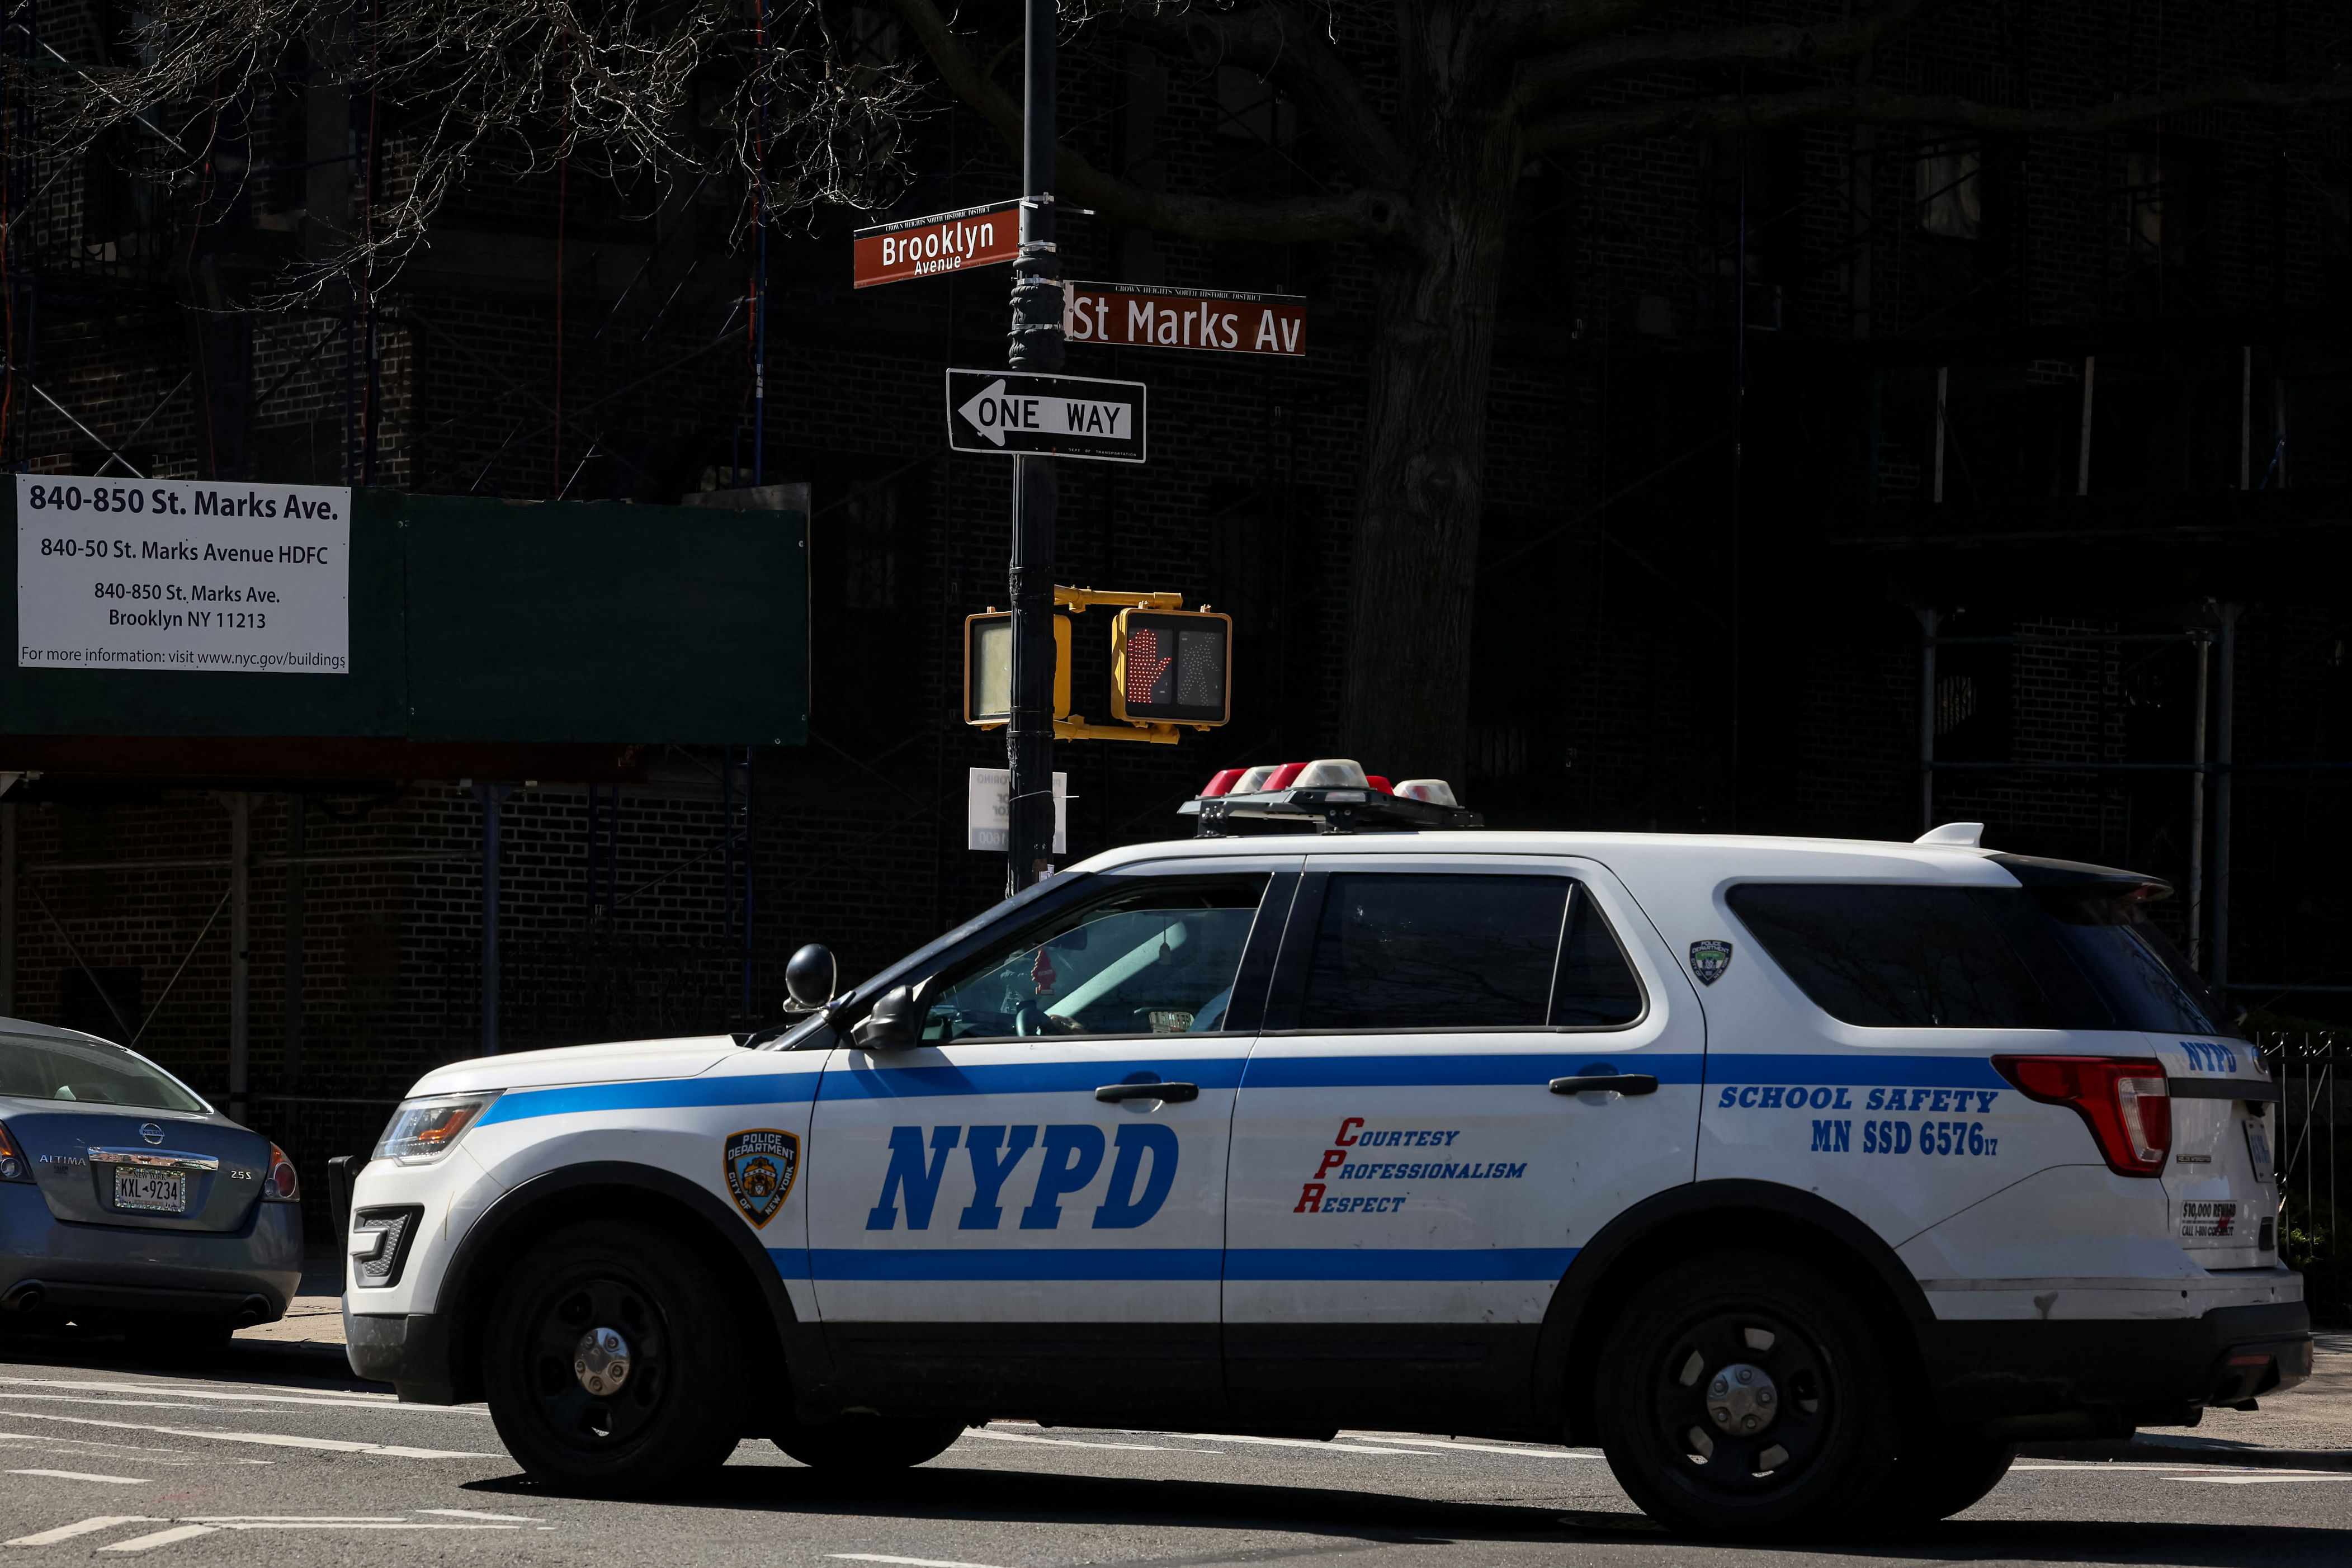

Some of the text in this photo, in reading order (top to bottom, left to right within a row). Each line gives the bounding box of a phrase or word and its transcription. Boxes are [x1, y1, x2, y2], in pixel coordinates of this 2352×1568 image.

[905, 219, 925, 229] HEIGHTS
[927, 215, 943, 224] NORTH
[945, 211, 967, 221] HISTORIC
[968, 206, 990, 216] DISTRICT
[882, 221, 993, 266] Brooklyn
[914, 256, 961, 276] Avenue
[1199, 290, 1230, 299] HISTORIC
[1232, 292, 1262, 301] DISTRICT
[1073, 296, 1301, 352] St Marks Av
[979, 398, 1121, 434] ONE WAY
[30, 485, 338, 520] 840-850 St. Marks Ave.
[41, 539, 328, 564] 840-50 St. Marks Avenue HDFC
[95, 583, 280, 603] 840-850 St. Marks Ave.
[110, 610, 266, 630] Brooklyn NY 11213
[22, 647, 345, 669] For more information: visit www.nyc.gov/buildings
[1692, 946, 1730, 954] DEPARTMENT
[2179, 1042, 2236, 1073] NYPD
[1718, 1087, 1999, 1113] SCHOOL SAFETY
[743, 1134, 782, 1145] POLICE
[1811, 1120, 1852, 1153] MN
[1863, 1121, 1912, 1154] SSD
[40, 1154, 86, 1166] ALTIMA
[728, 1143, 794, 1160] DEPARTMENT
[865, 1123, 1179, 1230] NYPD
[729, 1172, 751, 1210] CITY OF
[764, 1166, 794, 1215] NEW YORK
[2183, 1202, 2212, 1220] $10,000
[2182, 1225, 2193, 1236] CALL
